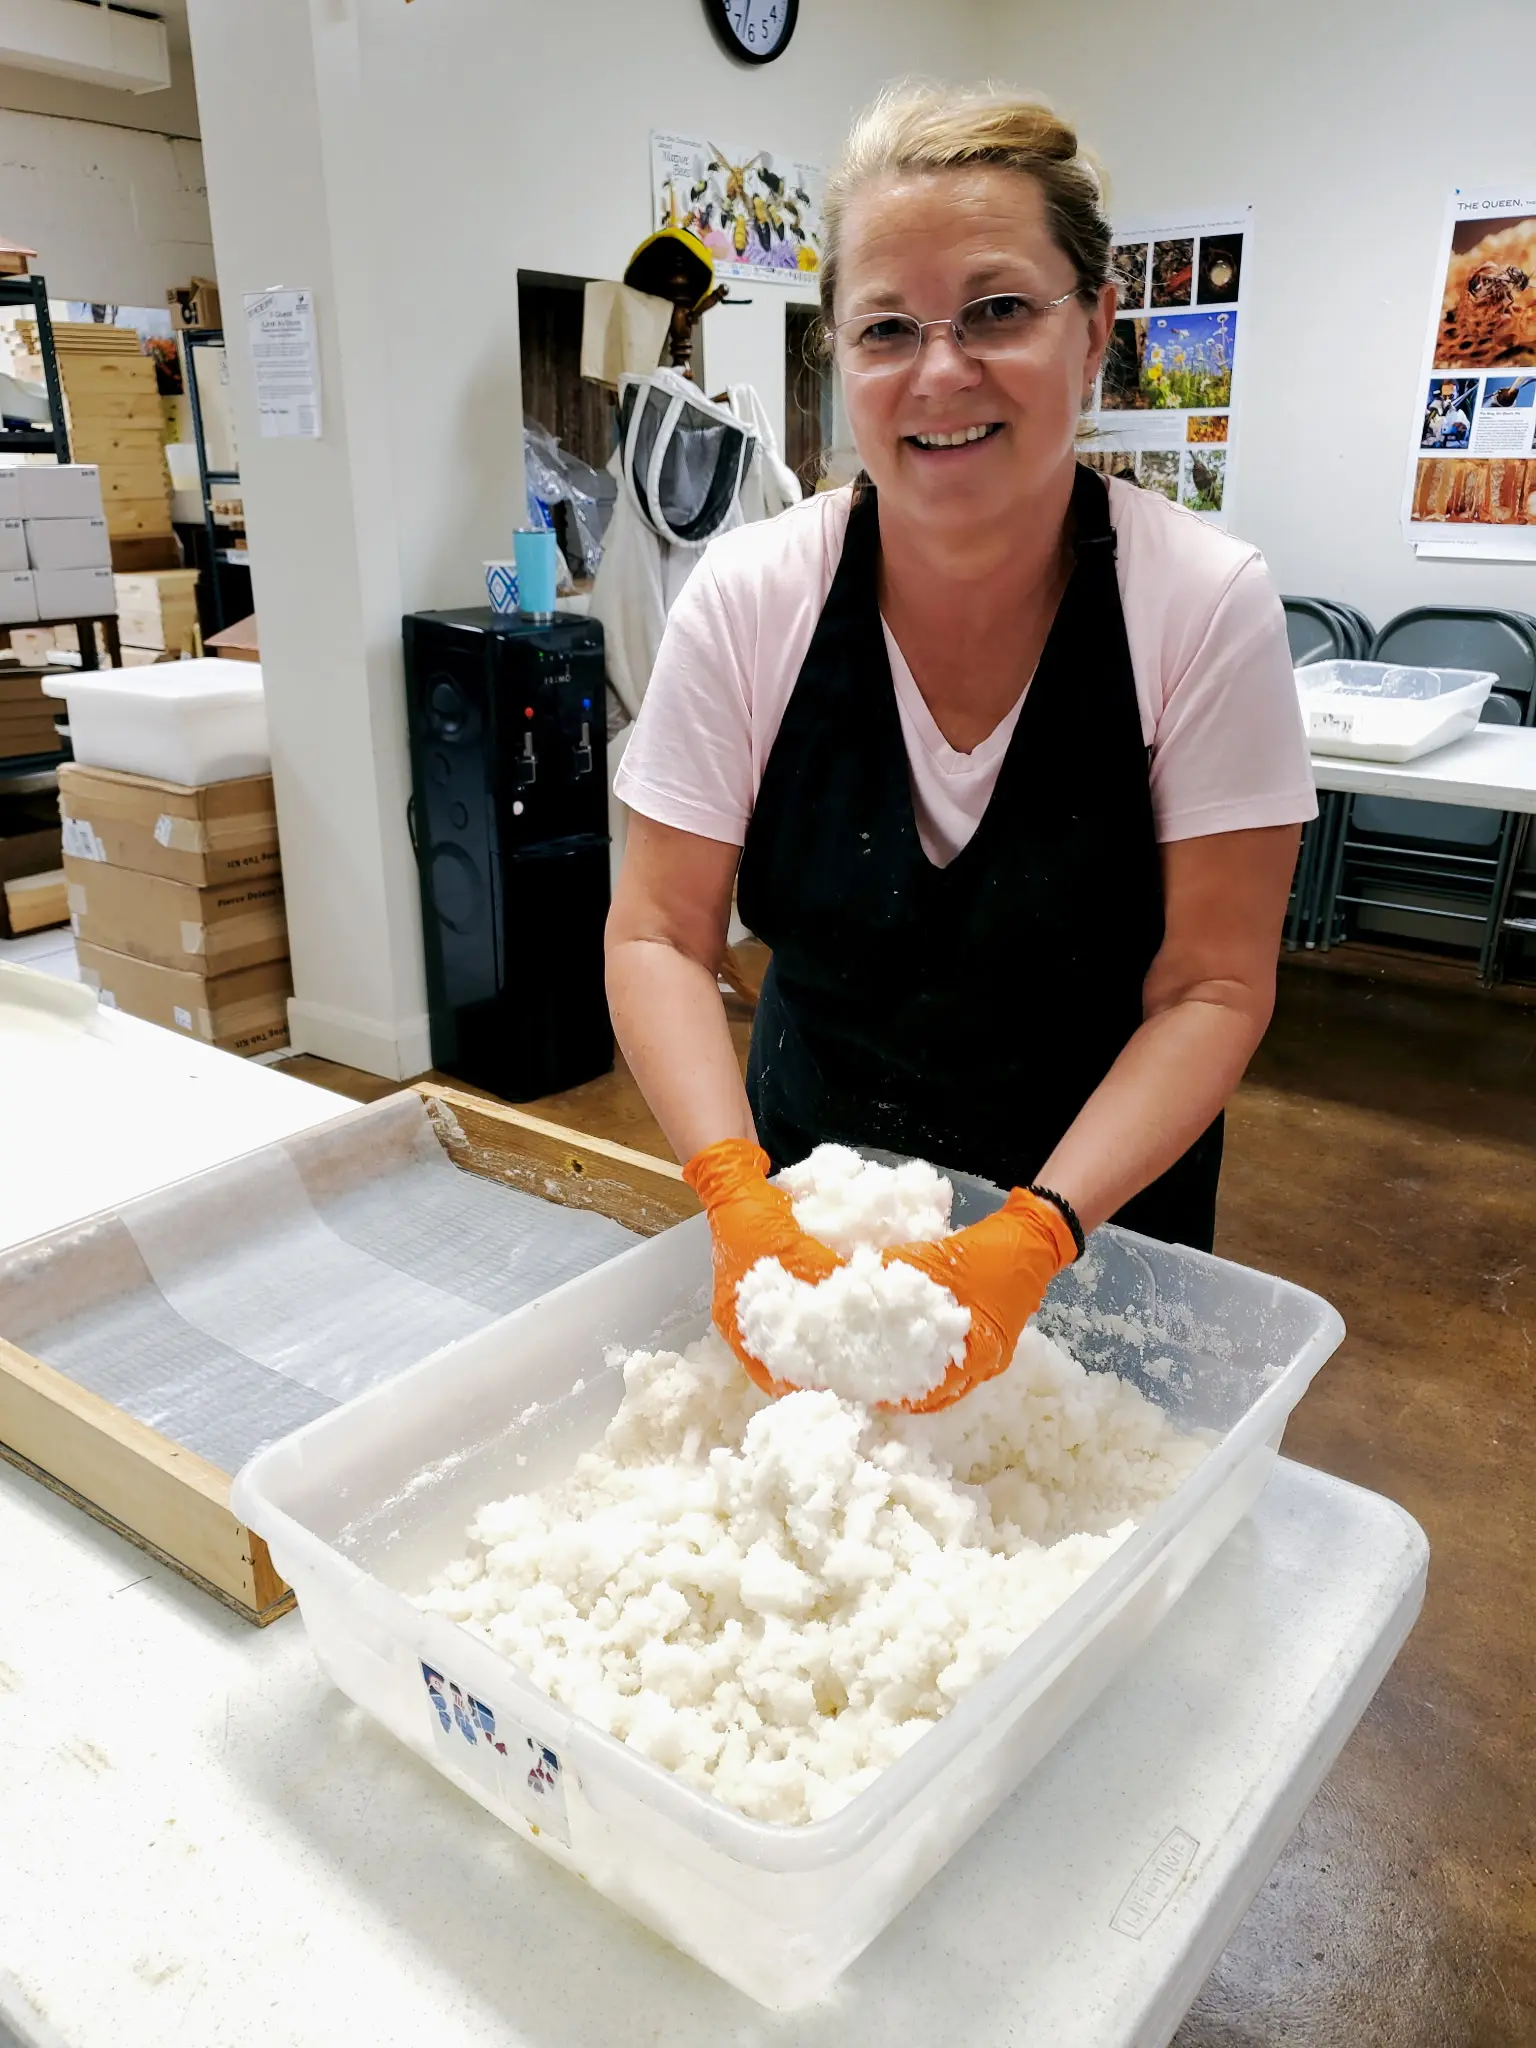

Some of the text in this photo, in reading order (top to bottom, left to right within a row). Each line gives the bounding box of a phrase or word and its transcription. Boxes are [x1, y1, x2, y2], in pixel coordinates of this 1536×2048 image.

[734, 13, 742, 33] 7
[769, 4, 778, 24] 4
[747, 23, 756, 43] 6
[761, 19, 769, 39] 5
[1457, 202, 1480, 211] THE
[1482, 199, 1524, 210] QUEEN,
[243, 855, 260, 866] Tub
[235, 1039, 249, 1049] Kit
[250, 1033, 267, 1044] Tub
[1120, 1841, 1186, 1930] LIFETIME
